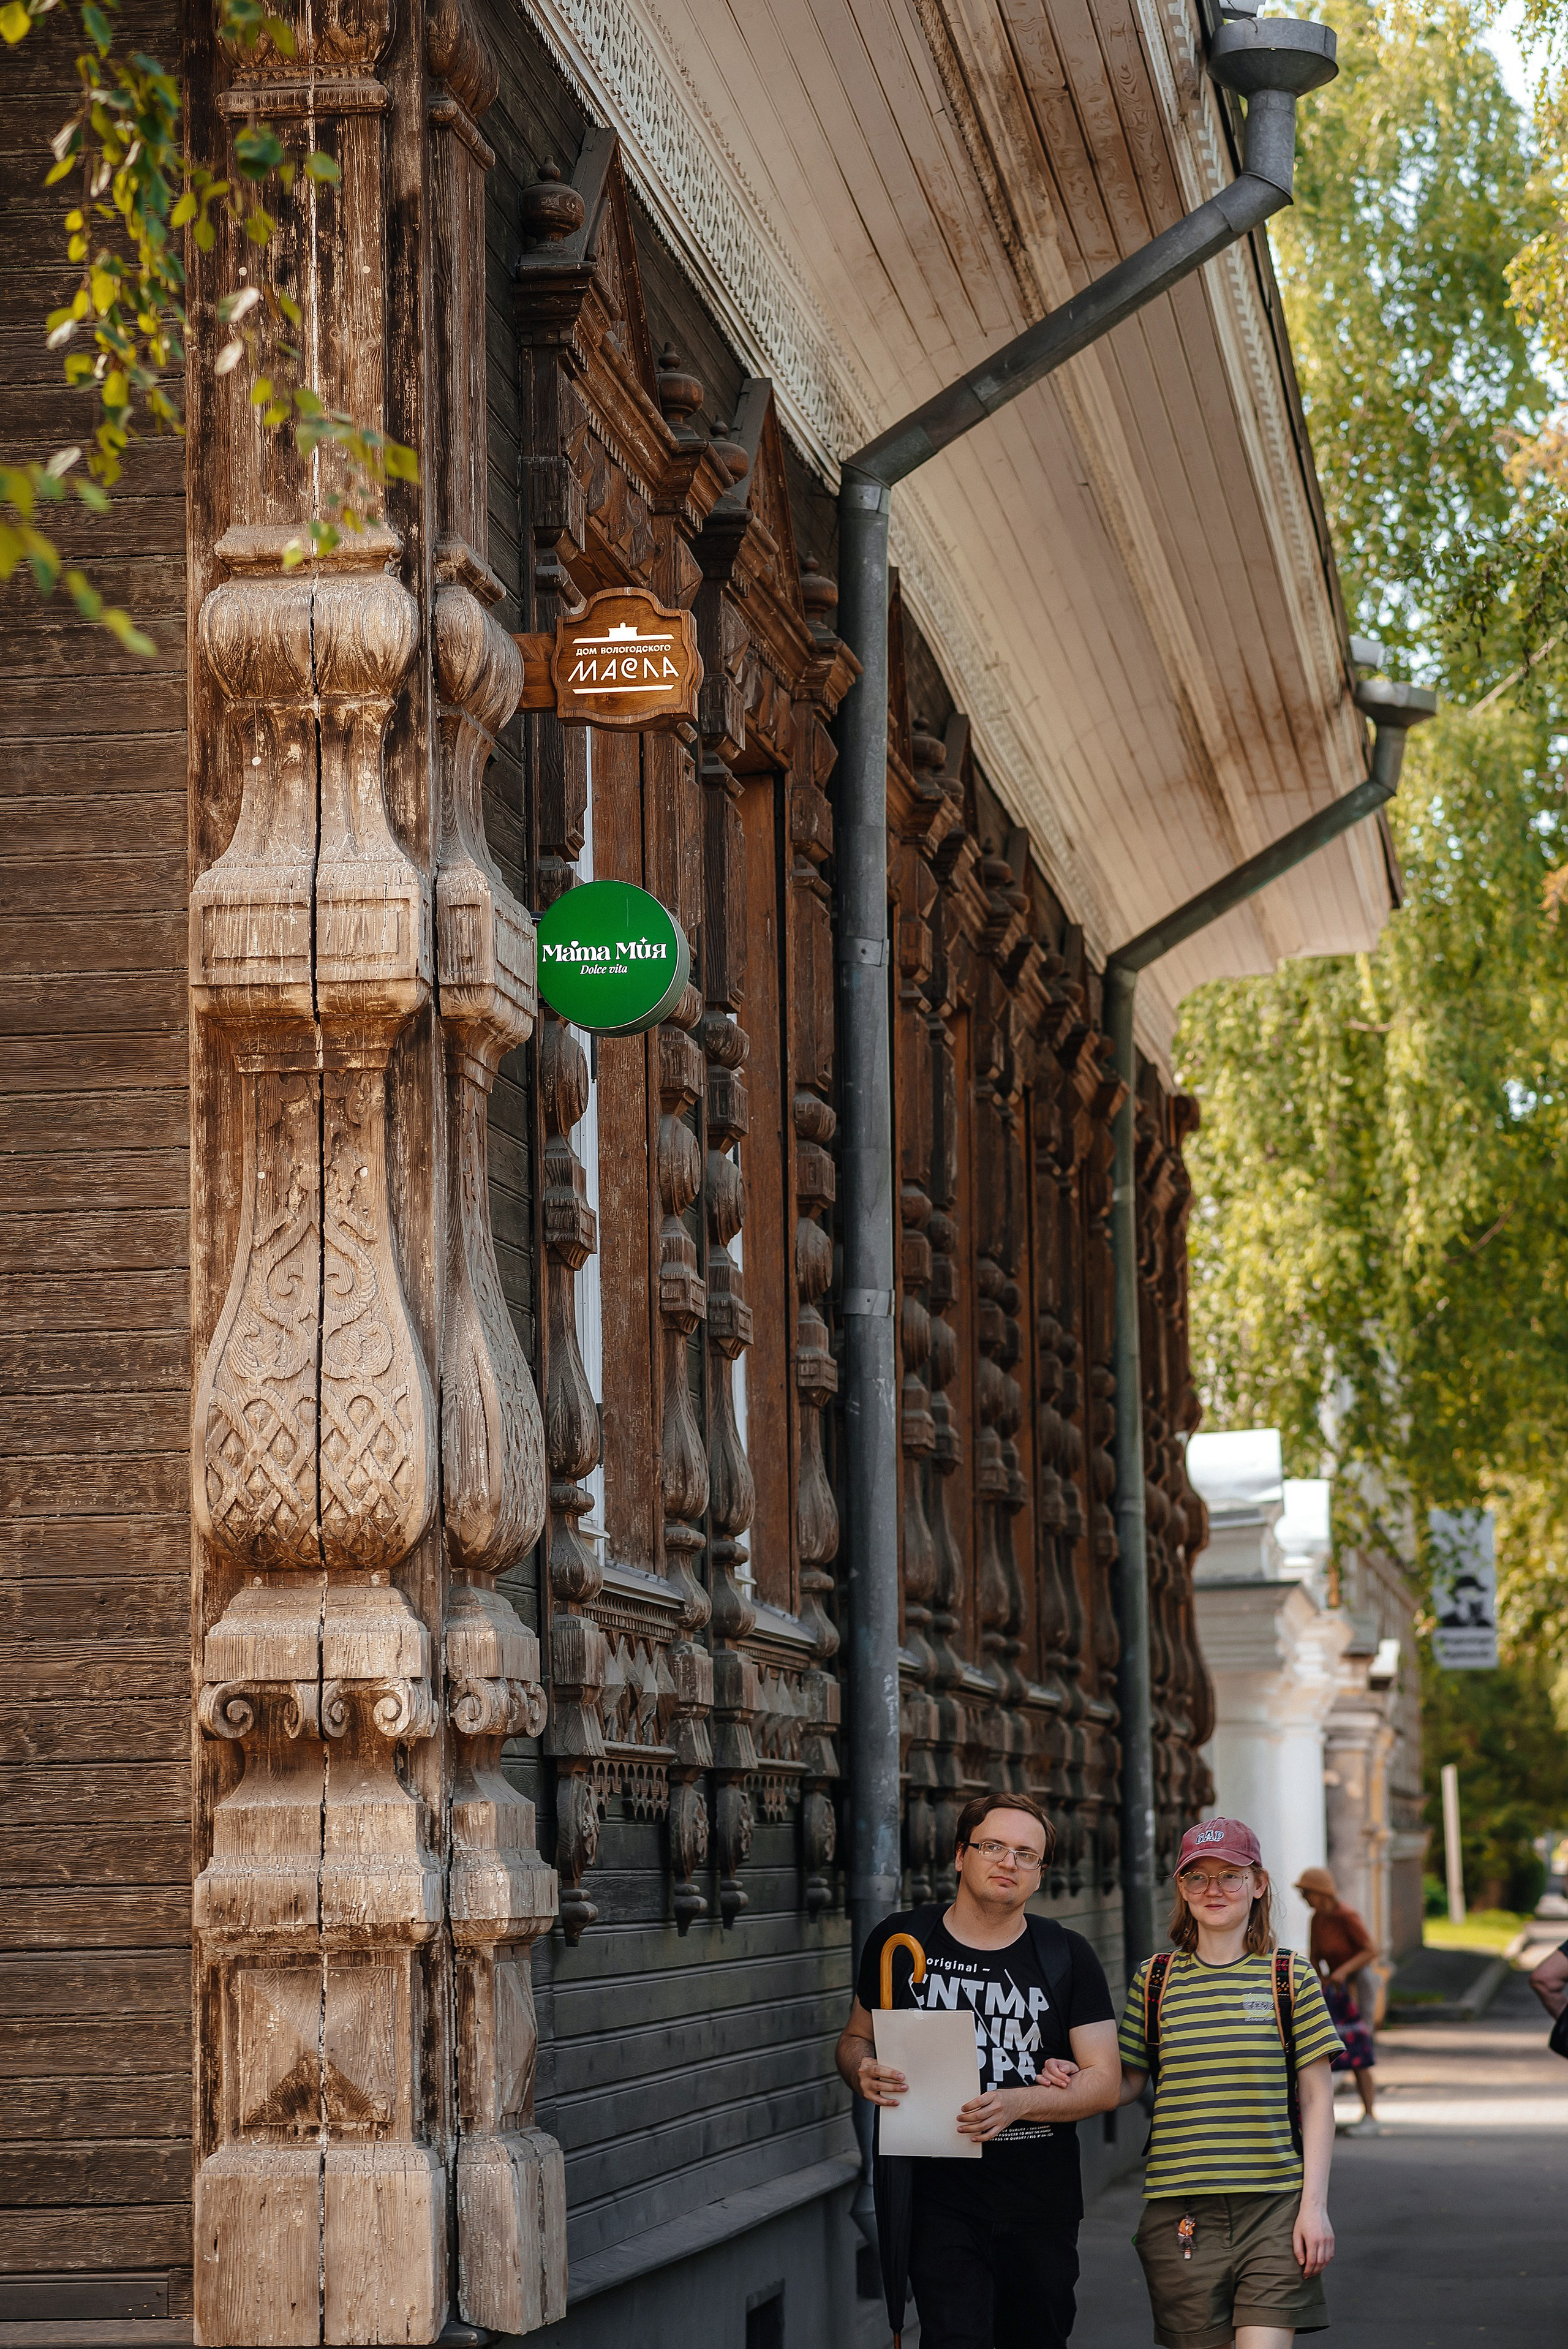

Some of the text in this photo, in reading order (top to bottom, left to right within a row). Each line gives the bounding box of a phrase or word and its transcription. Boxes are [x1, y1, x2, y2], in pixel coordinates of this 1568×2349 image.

[576, 644, 671, 656] ДОМ ВОЛОГОДСКОГО
[567, 656, 679, 682] МАСЛА
[580, 963, 628, 975] Dolce vita
[1196, 1830, 1224, 1845] GAP
[926, 1958, 978, 1973] original
